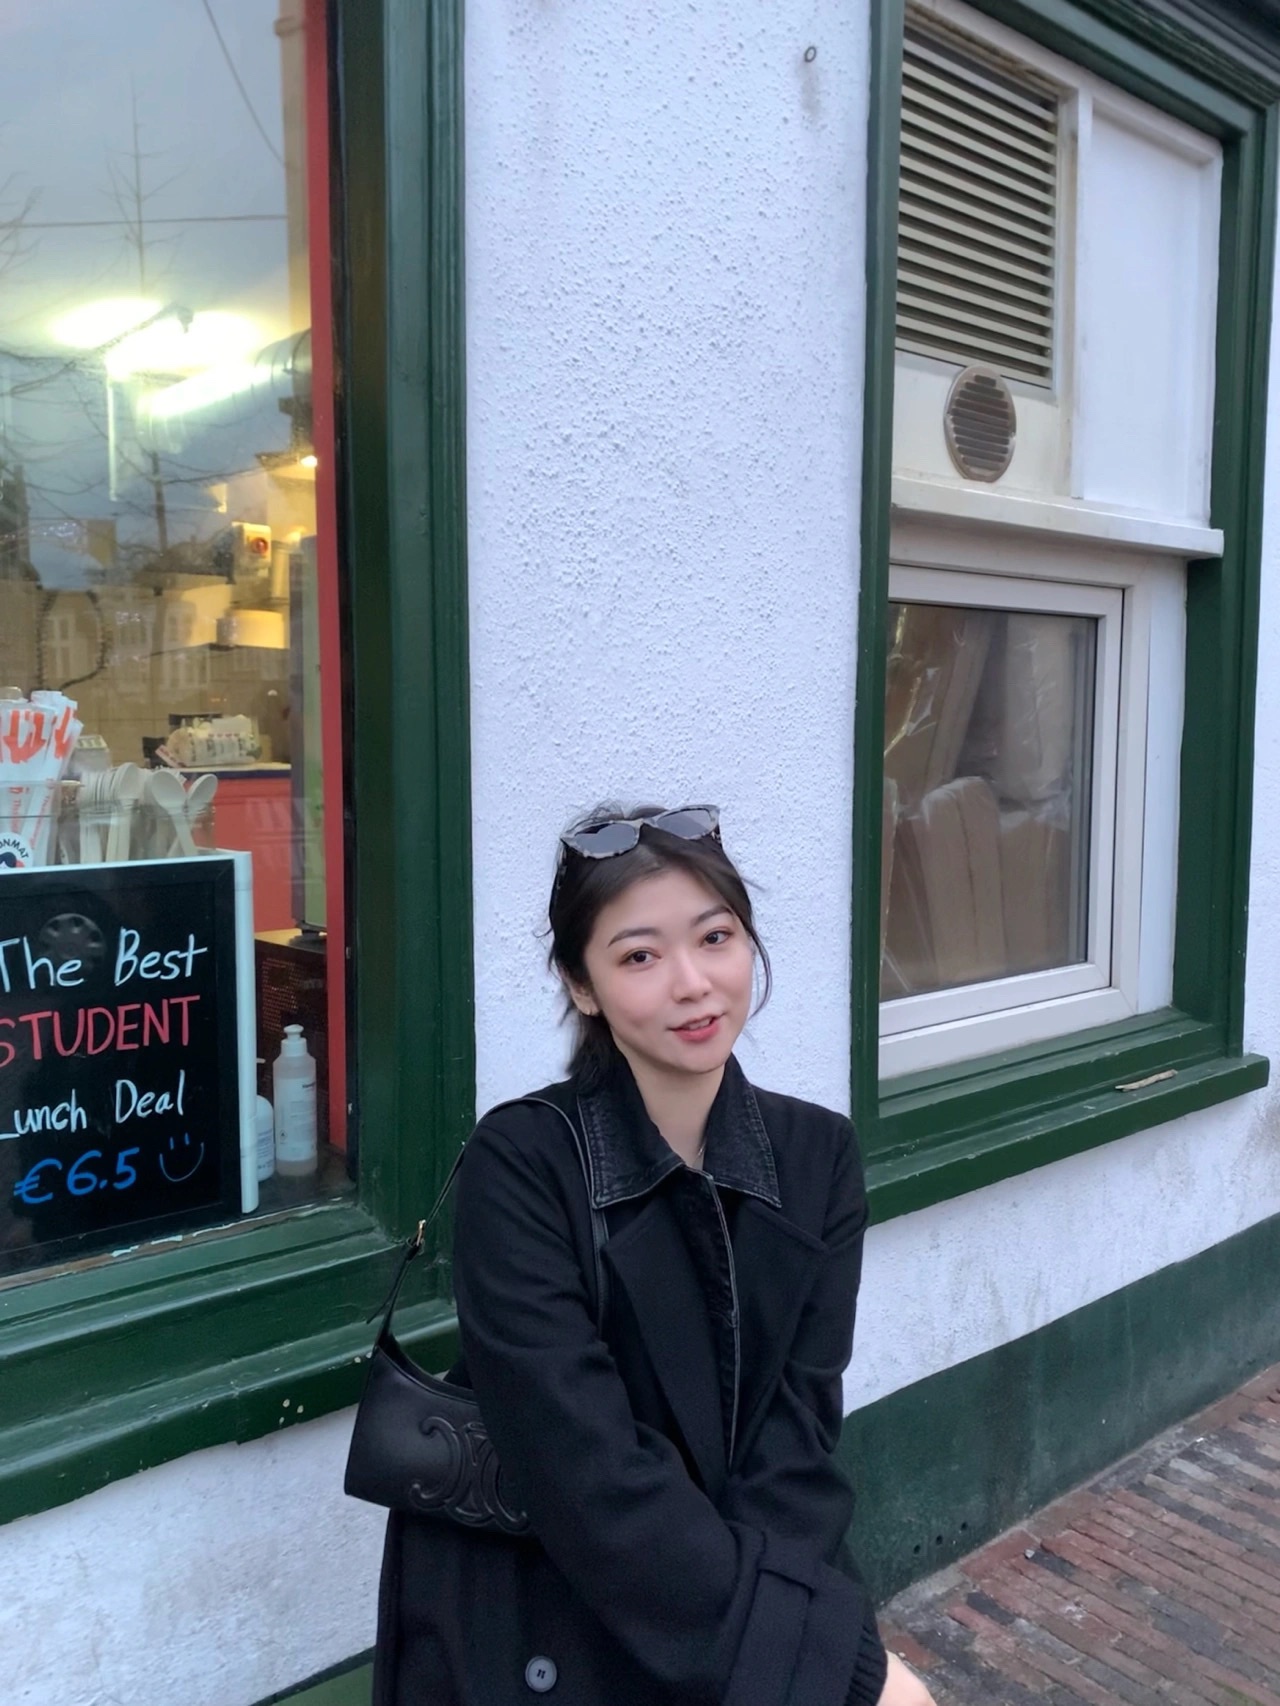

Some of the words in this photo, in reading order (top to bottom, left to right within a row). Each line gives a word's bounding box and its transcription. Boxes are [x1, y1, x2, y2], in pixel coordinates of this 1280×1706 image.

[0, 936, 85, 992] The
[114, 926, 208, 986] Best
[115, 1069, 185, 1123] Deal
[13, 1147, 140, 1204] €6.5
